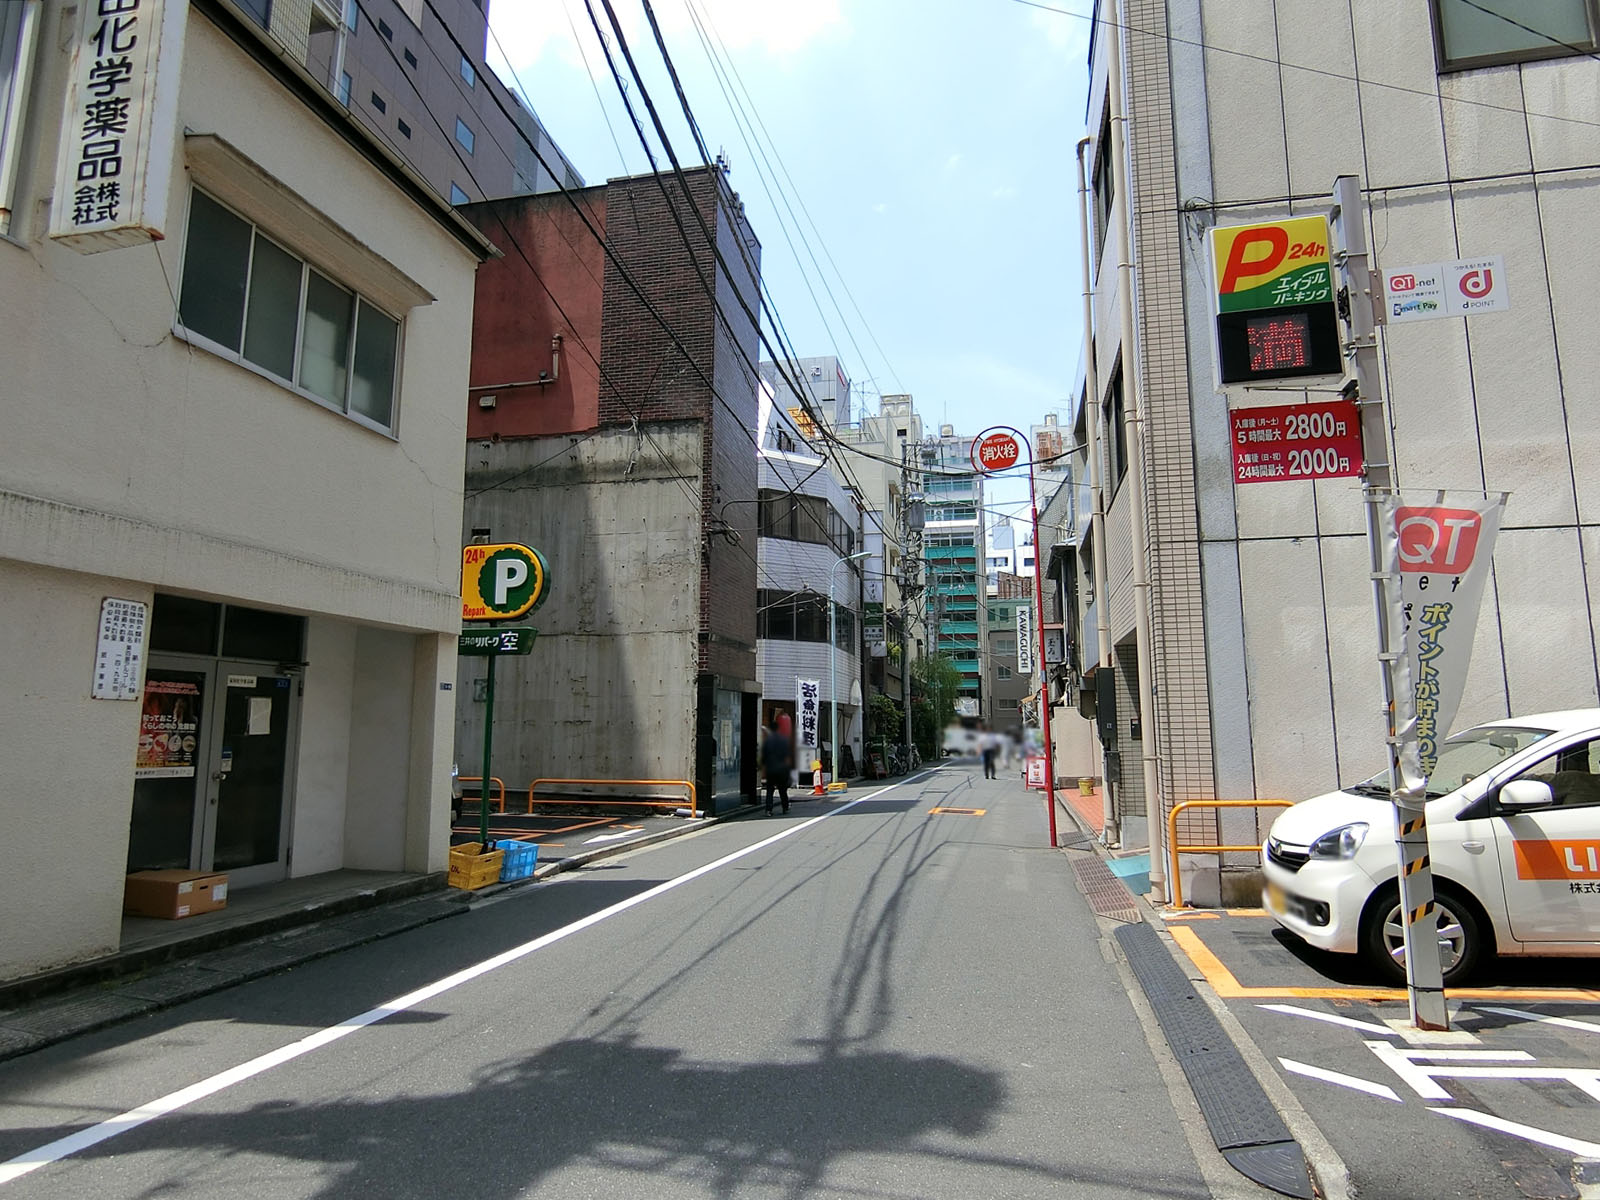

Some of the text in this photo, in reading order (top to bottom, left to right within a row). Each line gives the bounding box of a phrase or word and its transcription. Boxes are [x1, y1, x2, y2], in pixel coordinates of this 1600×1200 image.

[1219, 226, 1325, 295] P 24h
[1277, 268, 1326, 290] エイブル
[1271, 287, 1330, 305] パーキング
[1393, 301, 1437, 316] Smart Pay
[1247, 320, 1305, 371] 満
[1235, 418, 1256, 429] 入庫後
[1285, 412, 1346, 440] 2800円
[982, 443, 1016, 462] 消火栓
[1238, 453, 1258, 464] 入庫後
[1238, 447, 1350, 479] 24時間最大 2000円
[1399, 516, 1476, 565] QT
[465, 549, 485, 564] 24h
[494, 558, 528, 605] P
[463, 604, 486, 617] Repark
[500, 631, 519, 650] 空
[1019, 610, 1029, 668] KAWAGUCHI
[1415, 602, 1453, 784] ポイントが貯まりま
